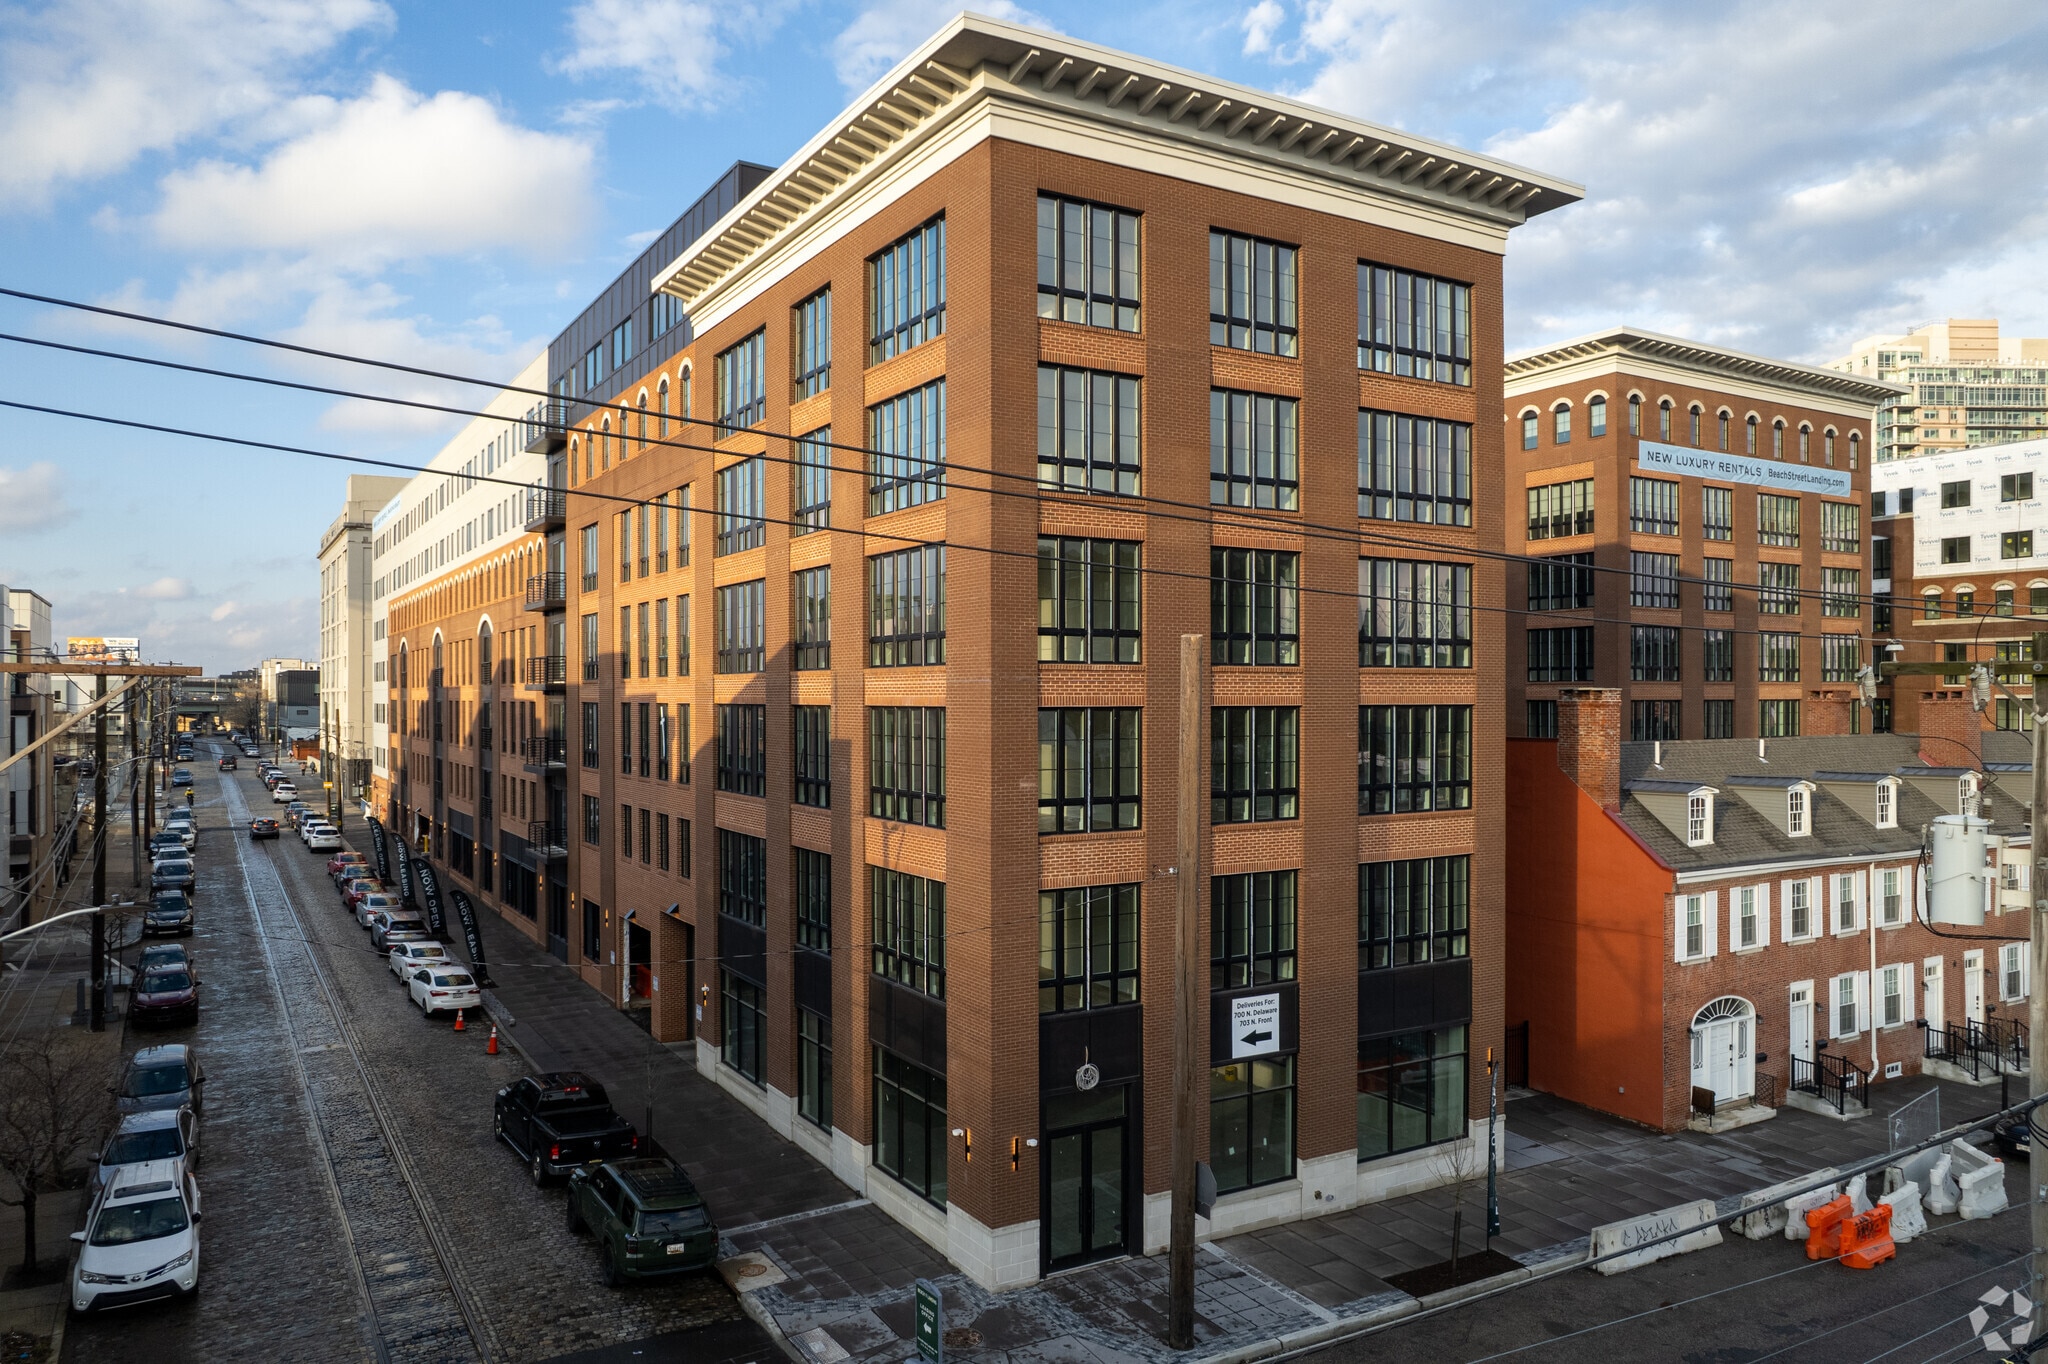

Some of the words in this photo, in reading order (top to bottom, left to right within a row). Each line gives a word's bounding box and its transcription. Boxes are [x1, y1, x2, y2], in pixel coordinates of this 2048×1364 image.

[1647, 451, 1672, 463] NEW
[1676, 458, 1715, 470] LUXURY
[1718, 462, 1762, 477] RENTALS
[1768, 468, 1845, 488] BeachStreetLanding.com
[399, 863, 410, 897] LEASING
[419, 869, 435, 896] NOW
[428, 900, 440, 929] OPEN
[458, 901, 470, 925] NOW
[1233, 1011, 1246, 1019] 700
[1253, 1008, 1278, 1016] Delaware
[1237, 1001, 1263, 1009] Deliveries
[1257, 1016, 1273, 1024] Front
